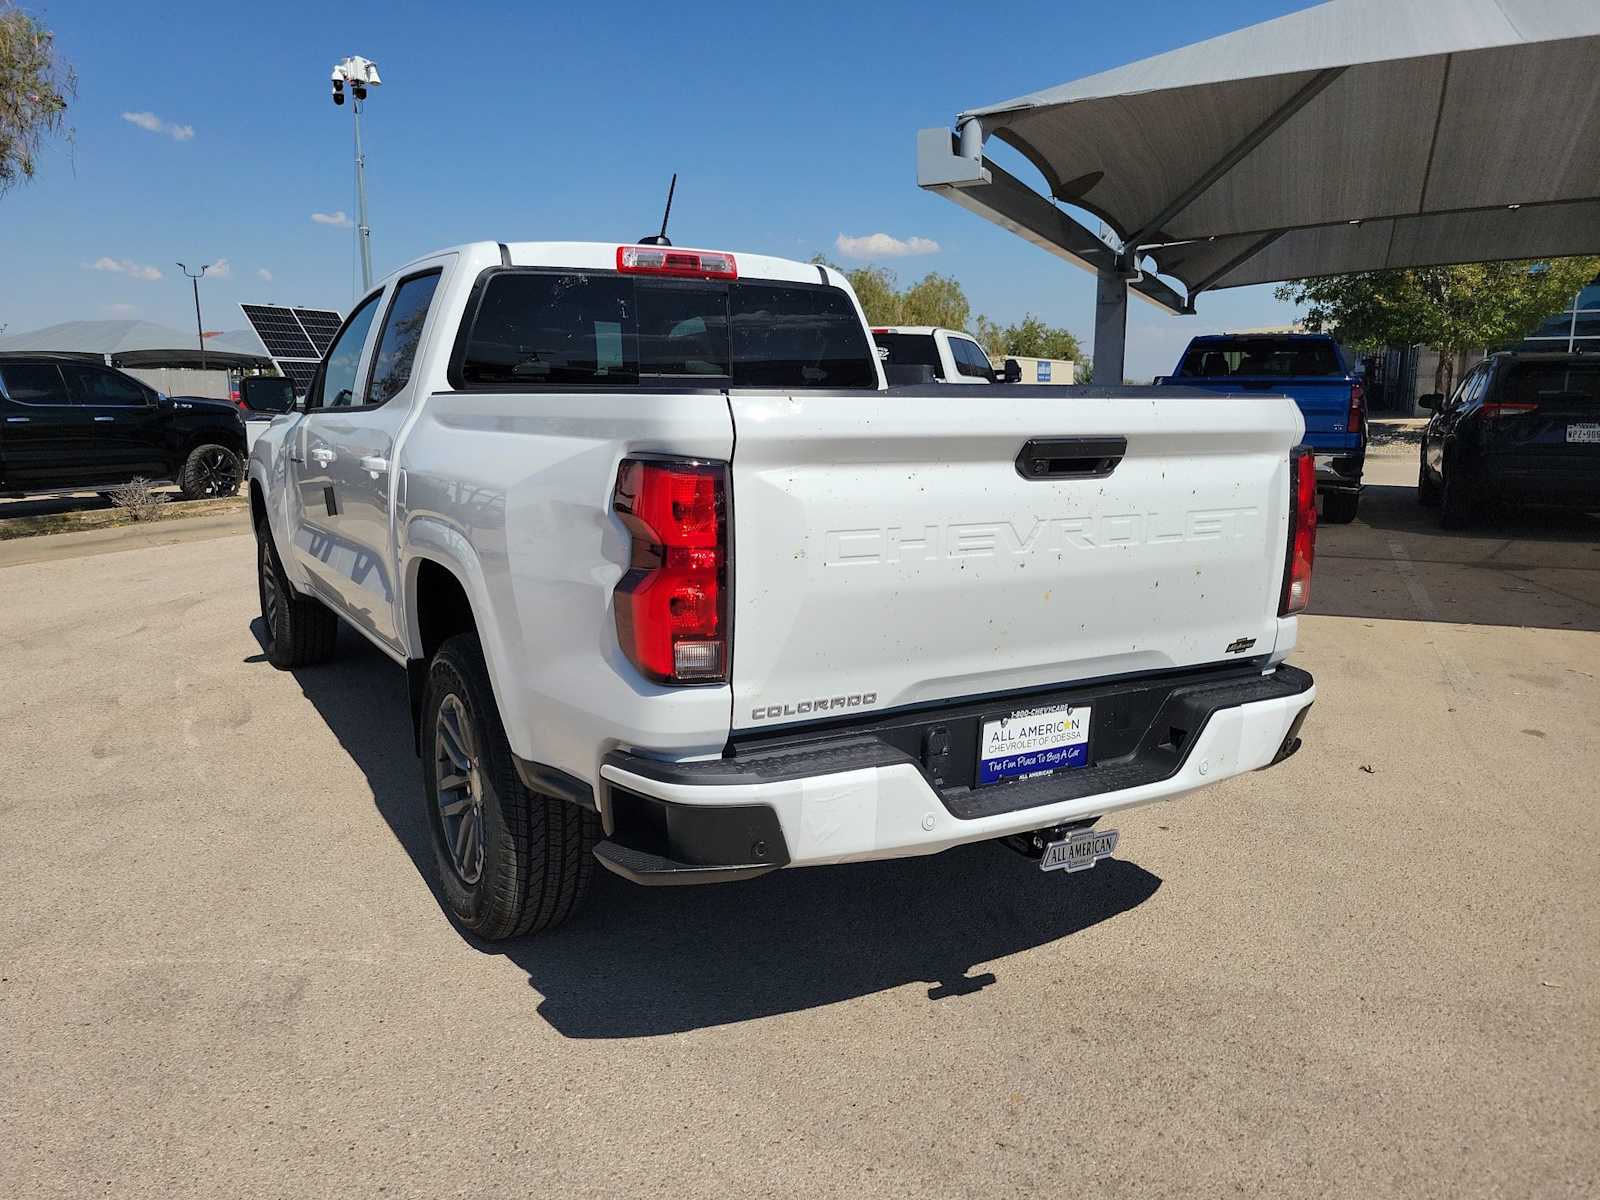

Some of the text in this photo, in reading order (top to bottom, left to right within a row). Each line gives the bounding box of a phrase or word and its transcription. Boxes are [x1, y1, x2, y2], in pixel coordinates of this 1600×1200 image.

[824, 506, 1258, 568] CHEVROLET
[752, 692, 877, 720] COLORADO
[989, 731, 1081, 753] CHEVROLET OF ODESSA
[991, 729, 1014, 743] ALL
[989, 748, 1080, 772] The Fun Place To Buy A Car
[1050, 845, 1068, 862] ALL
[1069, 836, 1113, 859] AMERICAN
